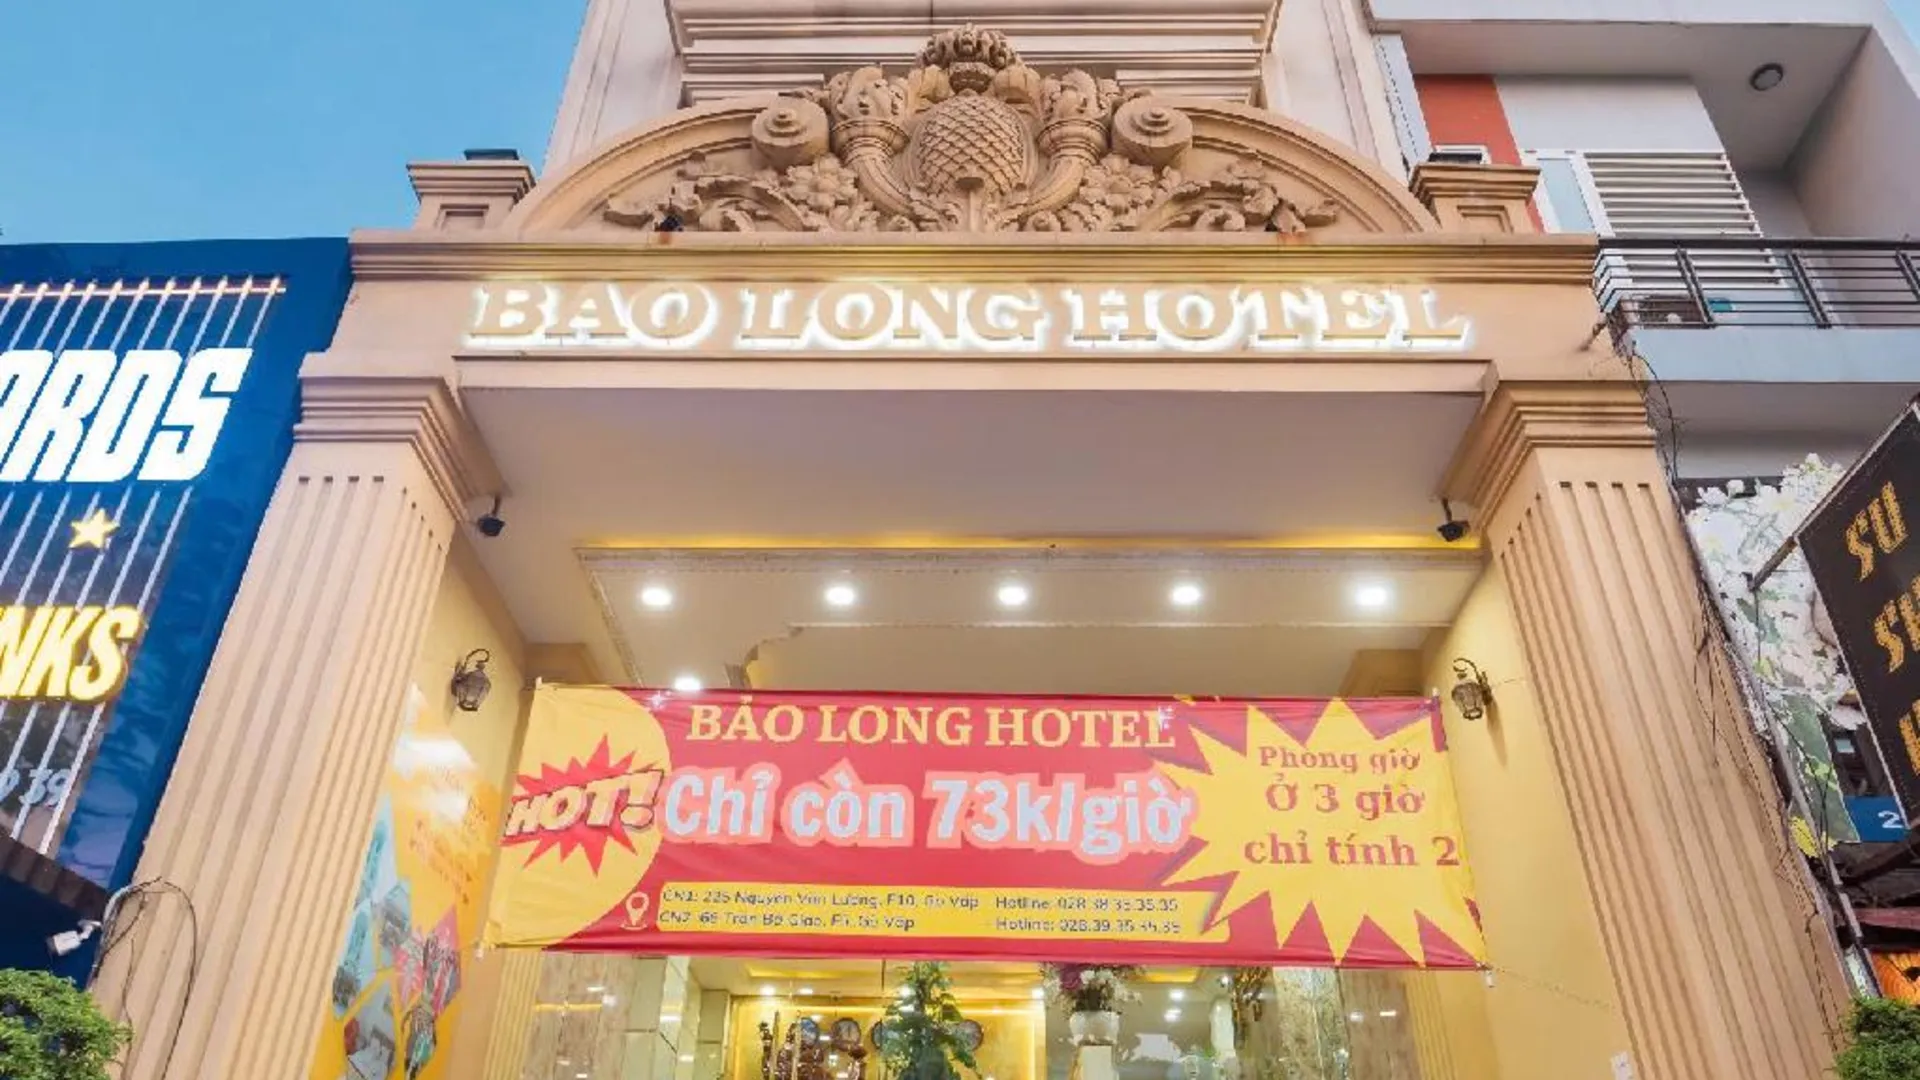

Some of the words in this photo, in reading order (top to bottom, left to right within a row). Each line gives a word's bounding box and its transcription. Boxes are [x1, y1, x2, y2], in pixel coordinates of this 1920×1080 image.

[467, 281, 714, 344] BAO
[738, 281, 1042, 346] LONG
[1066, 283, 1469, 348] HOTEL
[686, 696, 804, 743] BẢO
[817, 705, 973, 747] LONG
[985, 708, 1176, 749] HOTEL
[1369, 748, 1421, 775] giờ
[503, 769, 665, 837] HOT!
[665, 769, 775, 837] Chỉ
[790, 769, 905, 839] còn
[931, 778, 1192, 856] 73k/giờ
[1265, 772, 1298, 812] Ở
[1314, 783, 1340, 814] 3
[1355, 782, 1426, 821] giờ
[1244, 829, 1312, 865] chỉ
[1325, 832, 1419, 866] tính
[1431, 835, 1460, 867] 2
